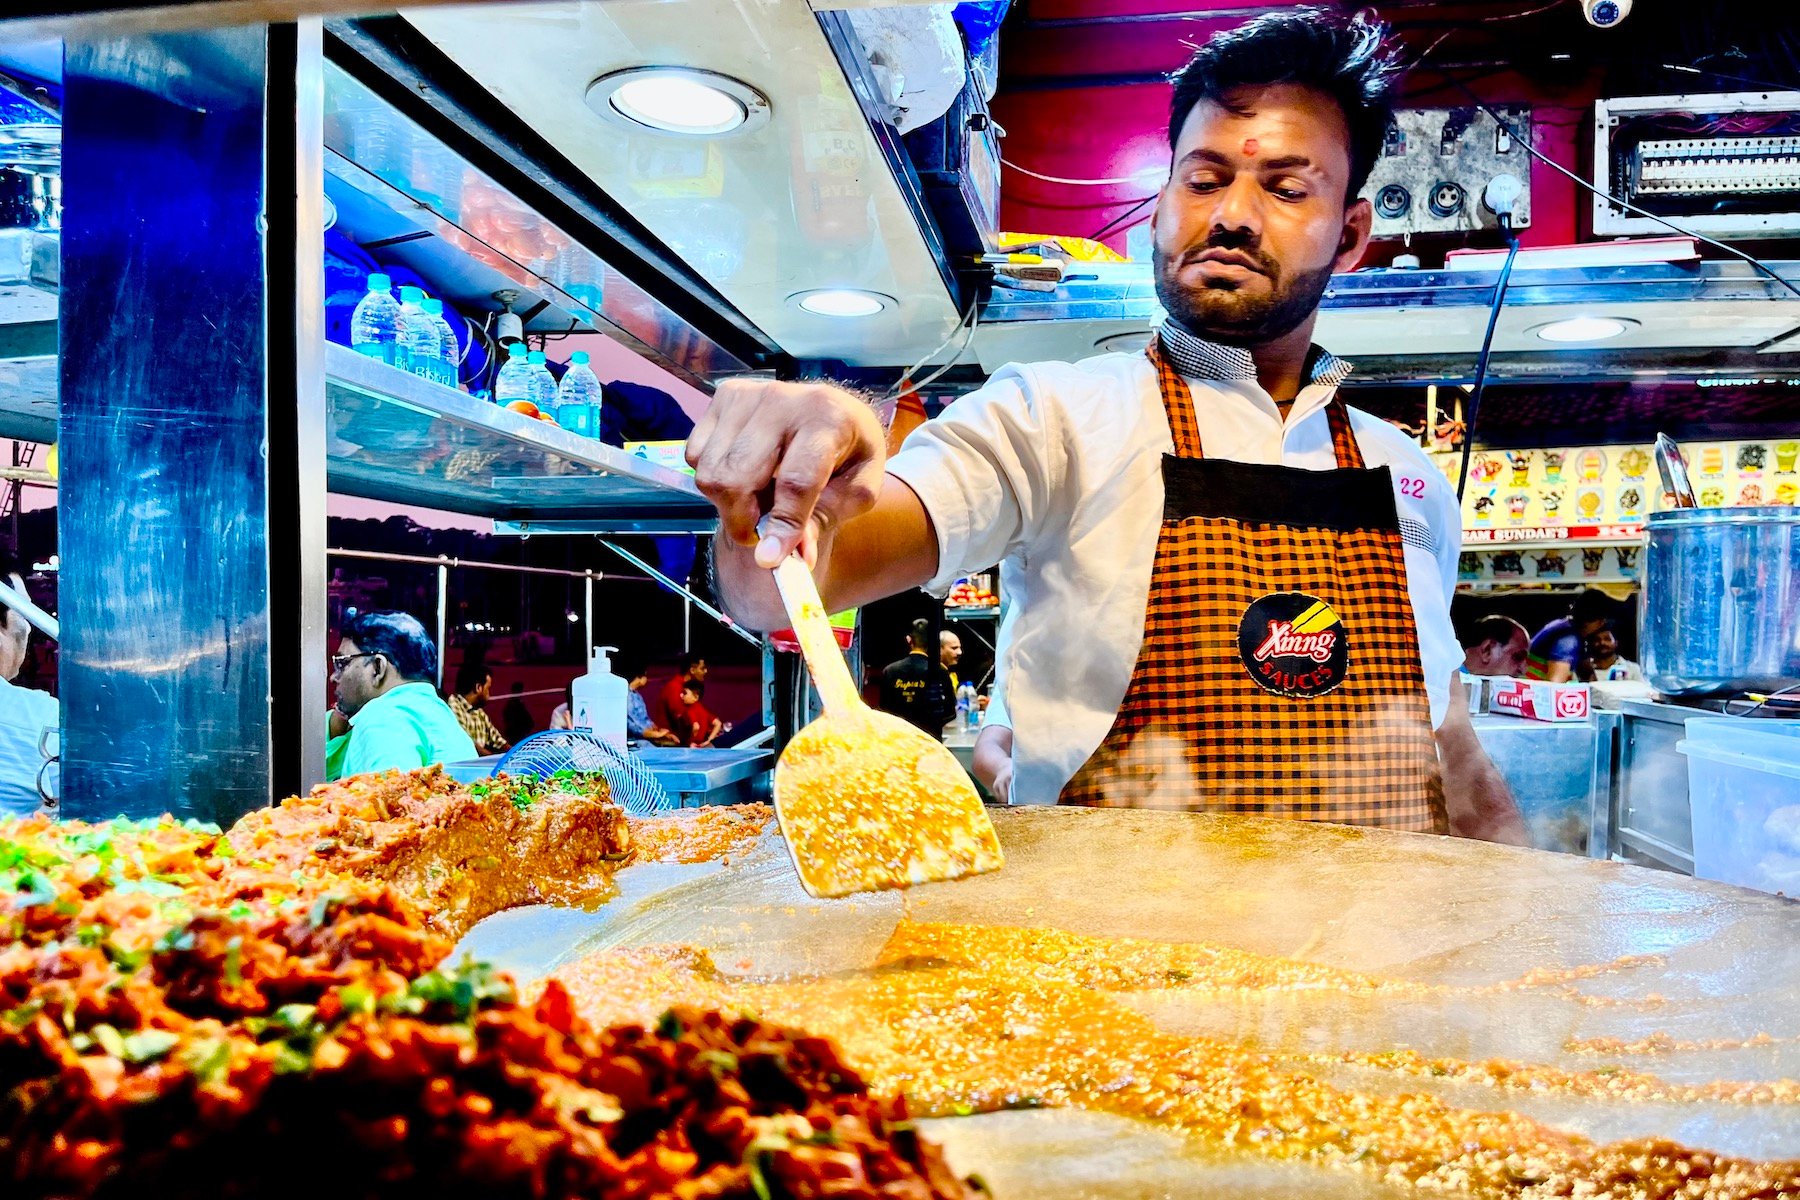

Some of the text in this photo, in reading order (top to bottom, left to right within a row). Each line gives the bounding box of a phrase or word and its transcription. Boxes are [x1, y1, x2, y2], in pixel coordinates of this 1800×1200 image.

[1400, 477, 1425, 499] 22
[1494, 527, 1569, 540] SUNDAE'S
[1254, 619, 1336, 661] Xinng
[1258, 661, 1333, 690] SAUCES
